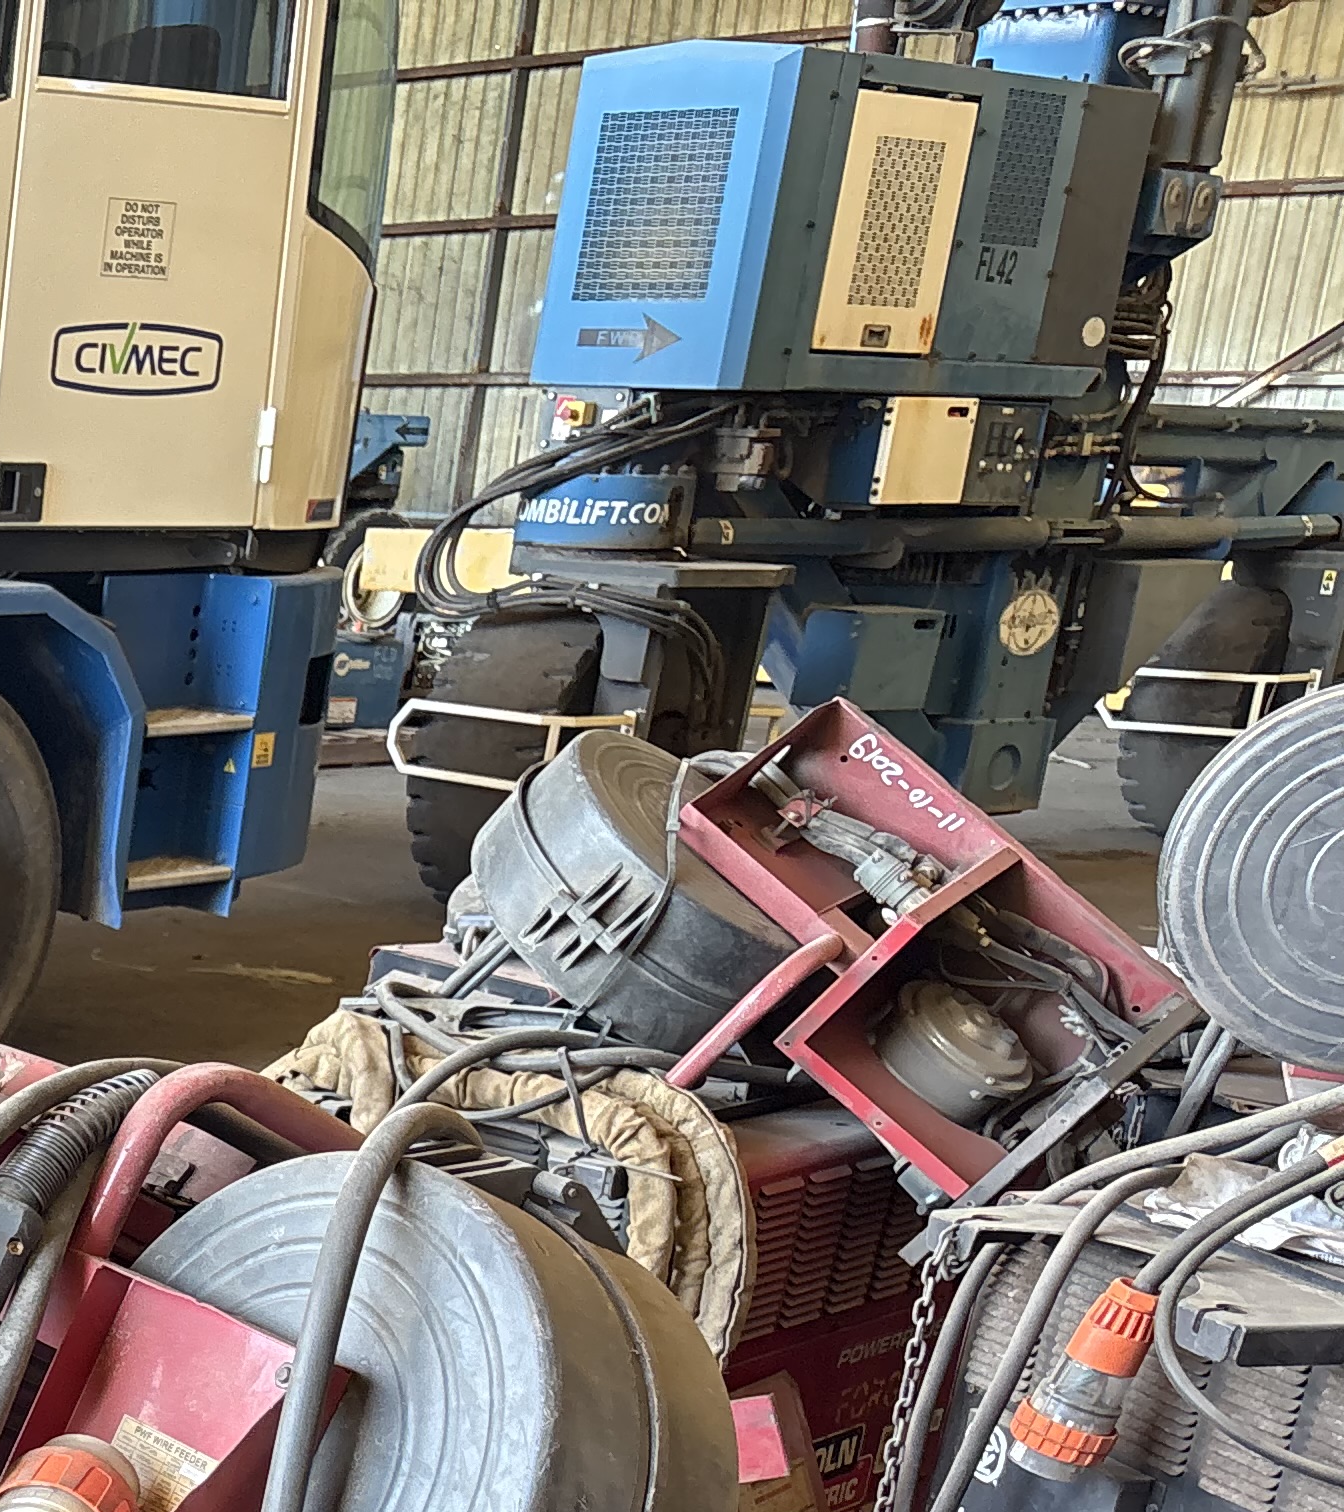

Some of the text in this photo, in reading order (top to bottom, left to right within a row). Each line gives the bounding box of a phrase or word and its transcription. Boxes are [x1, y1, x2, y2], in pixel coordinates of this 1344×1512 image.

[125, 202, 160, 214] DO NOT
[121, 214, 160, 227] DISTURB
[115, 226, 164, 239] OPERATOR
[124, 239, 152, 250] WHILE
[110, 250, 163, 263] MACHINE IS
[104, 262, 167, 276] IN OPERATION
[975, 246, 1019, 285] FL42
[75, 322, 203, 377] CIVMEC
[153, 1436, 174, 1452] WIRE
[174, 1446, 208, 1470] FEEDER
